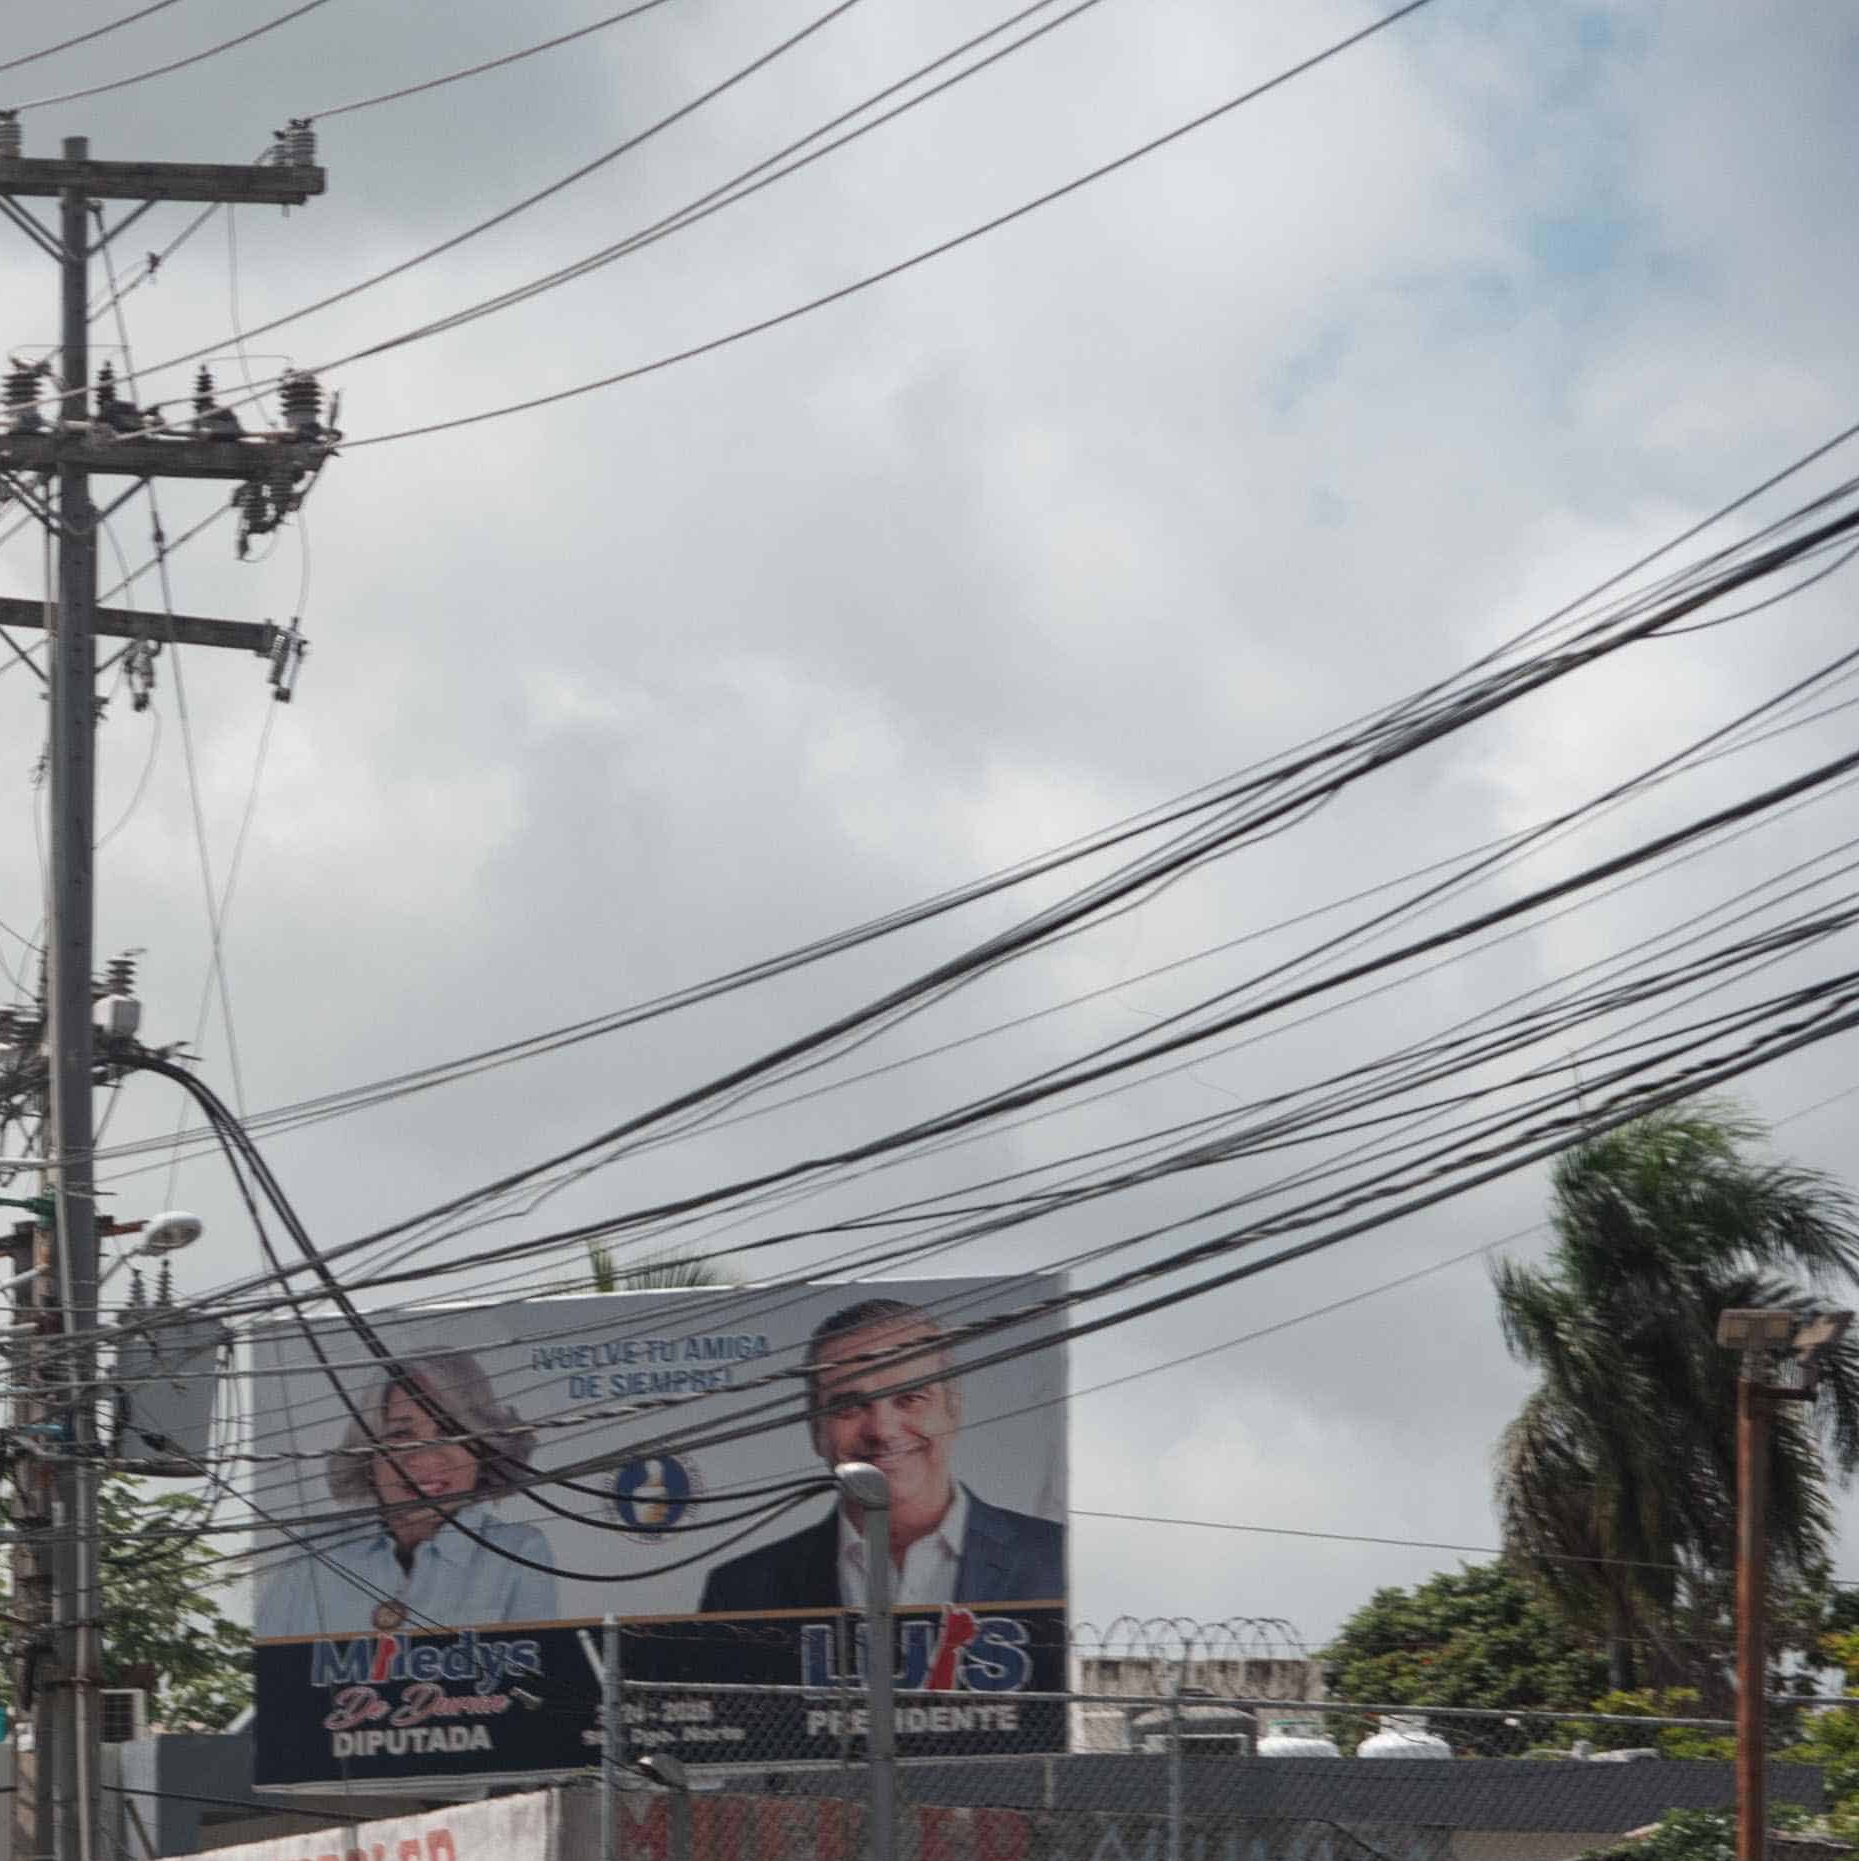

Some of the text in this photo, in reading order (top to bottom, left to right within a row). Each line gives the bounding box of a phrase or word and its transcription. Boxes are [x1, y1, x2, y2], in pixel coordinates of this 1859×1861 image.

[683, 1334, 769, 1361] AMIGA
[569, 1375, 603, 1399] DE
[806, 1704, 1019, 1735] PREIDENTE
[333, 1725, 492, 1758] DIPUTADA
